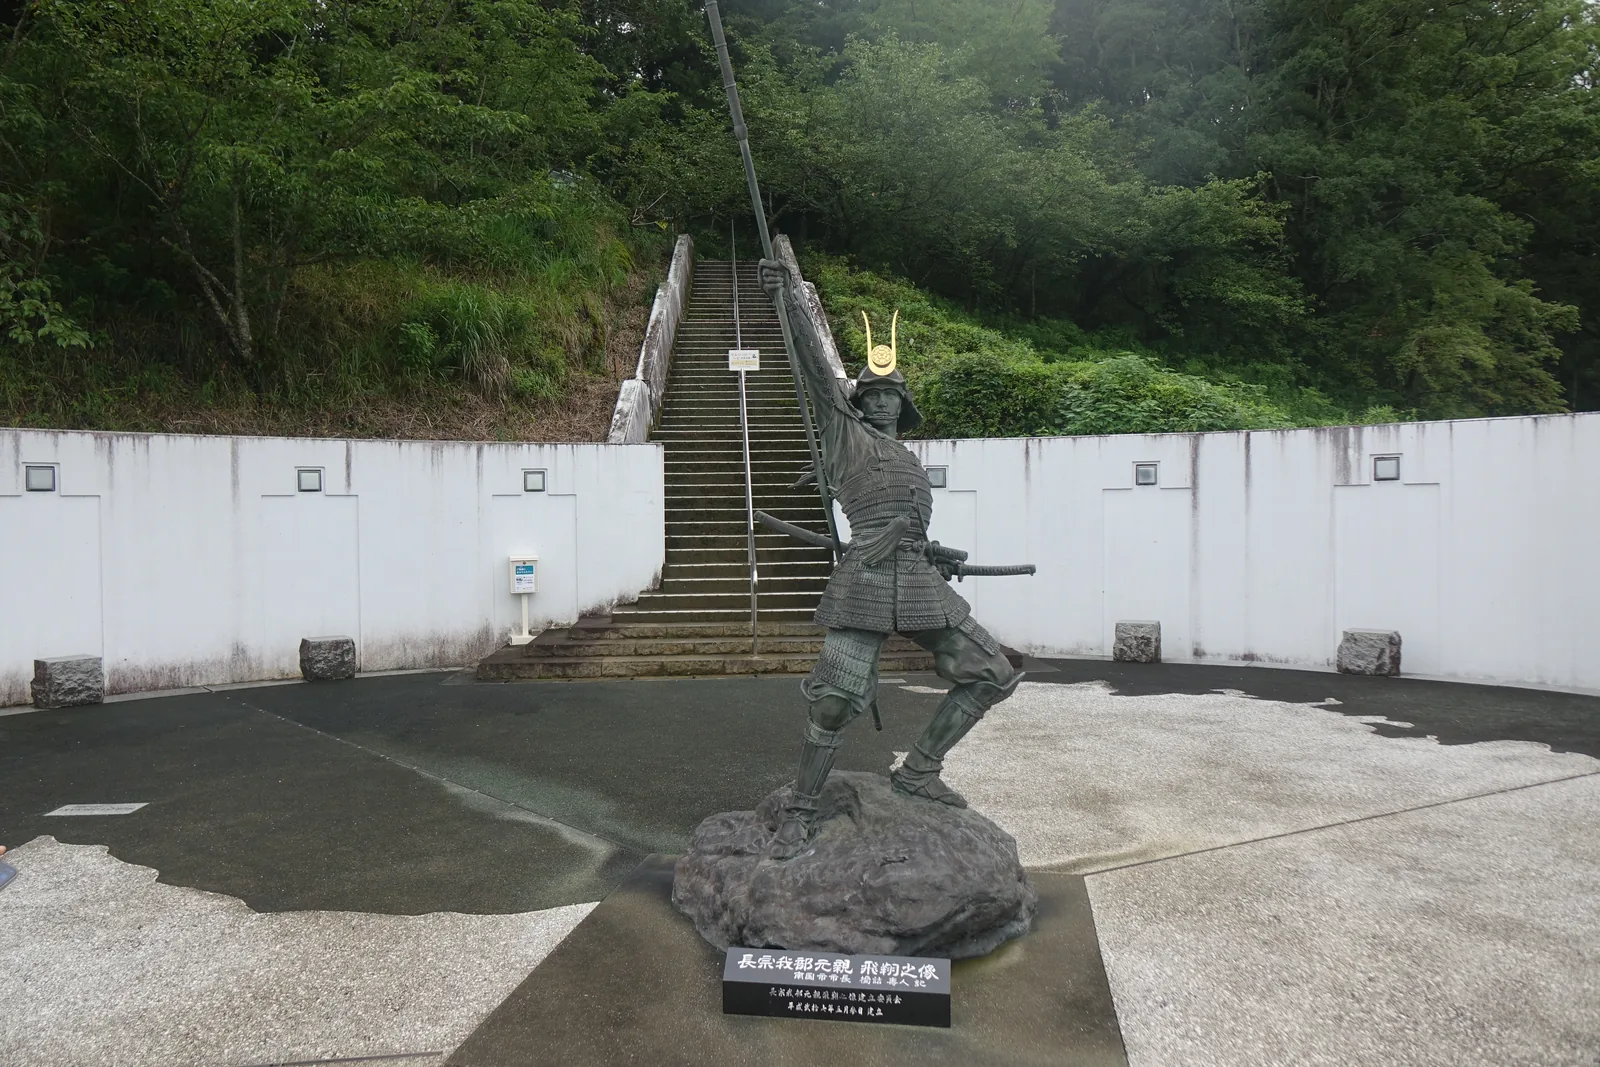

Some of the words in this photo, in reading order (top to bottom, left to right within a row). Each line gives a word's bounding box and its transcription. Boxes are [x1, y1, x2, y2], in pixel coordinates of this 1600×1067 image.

[738, 953, 854, 975] 長宗我部元親
[860, 960, 940, 980] 飛翔之像
[793, 971, 852, 984] 南国市市長
[866, 1006, 884, 1017] 建立
